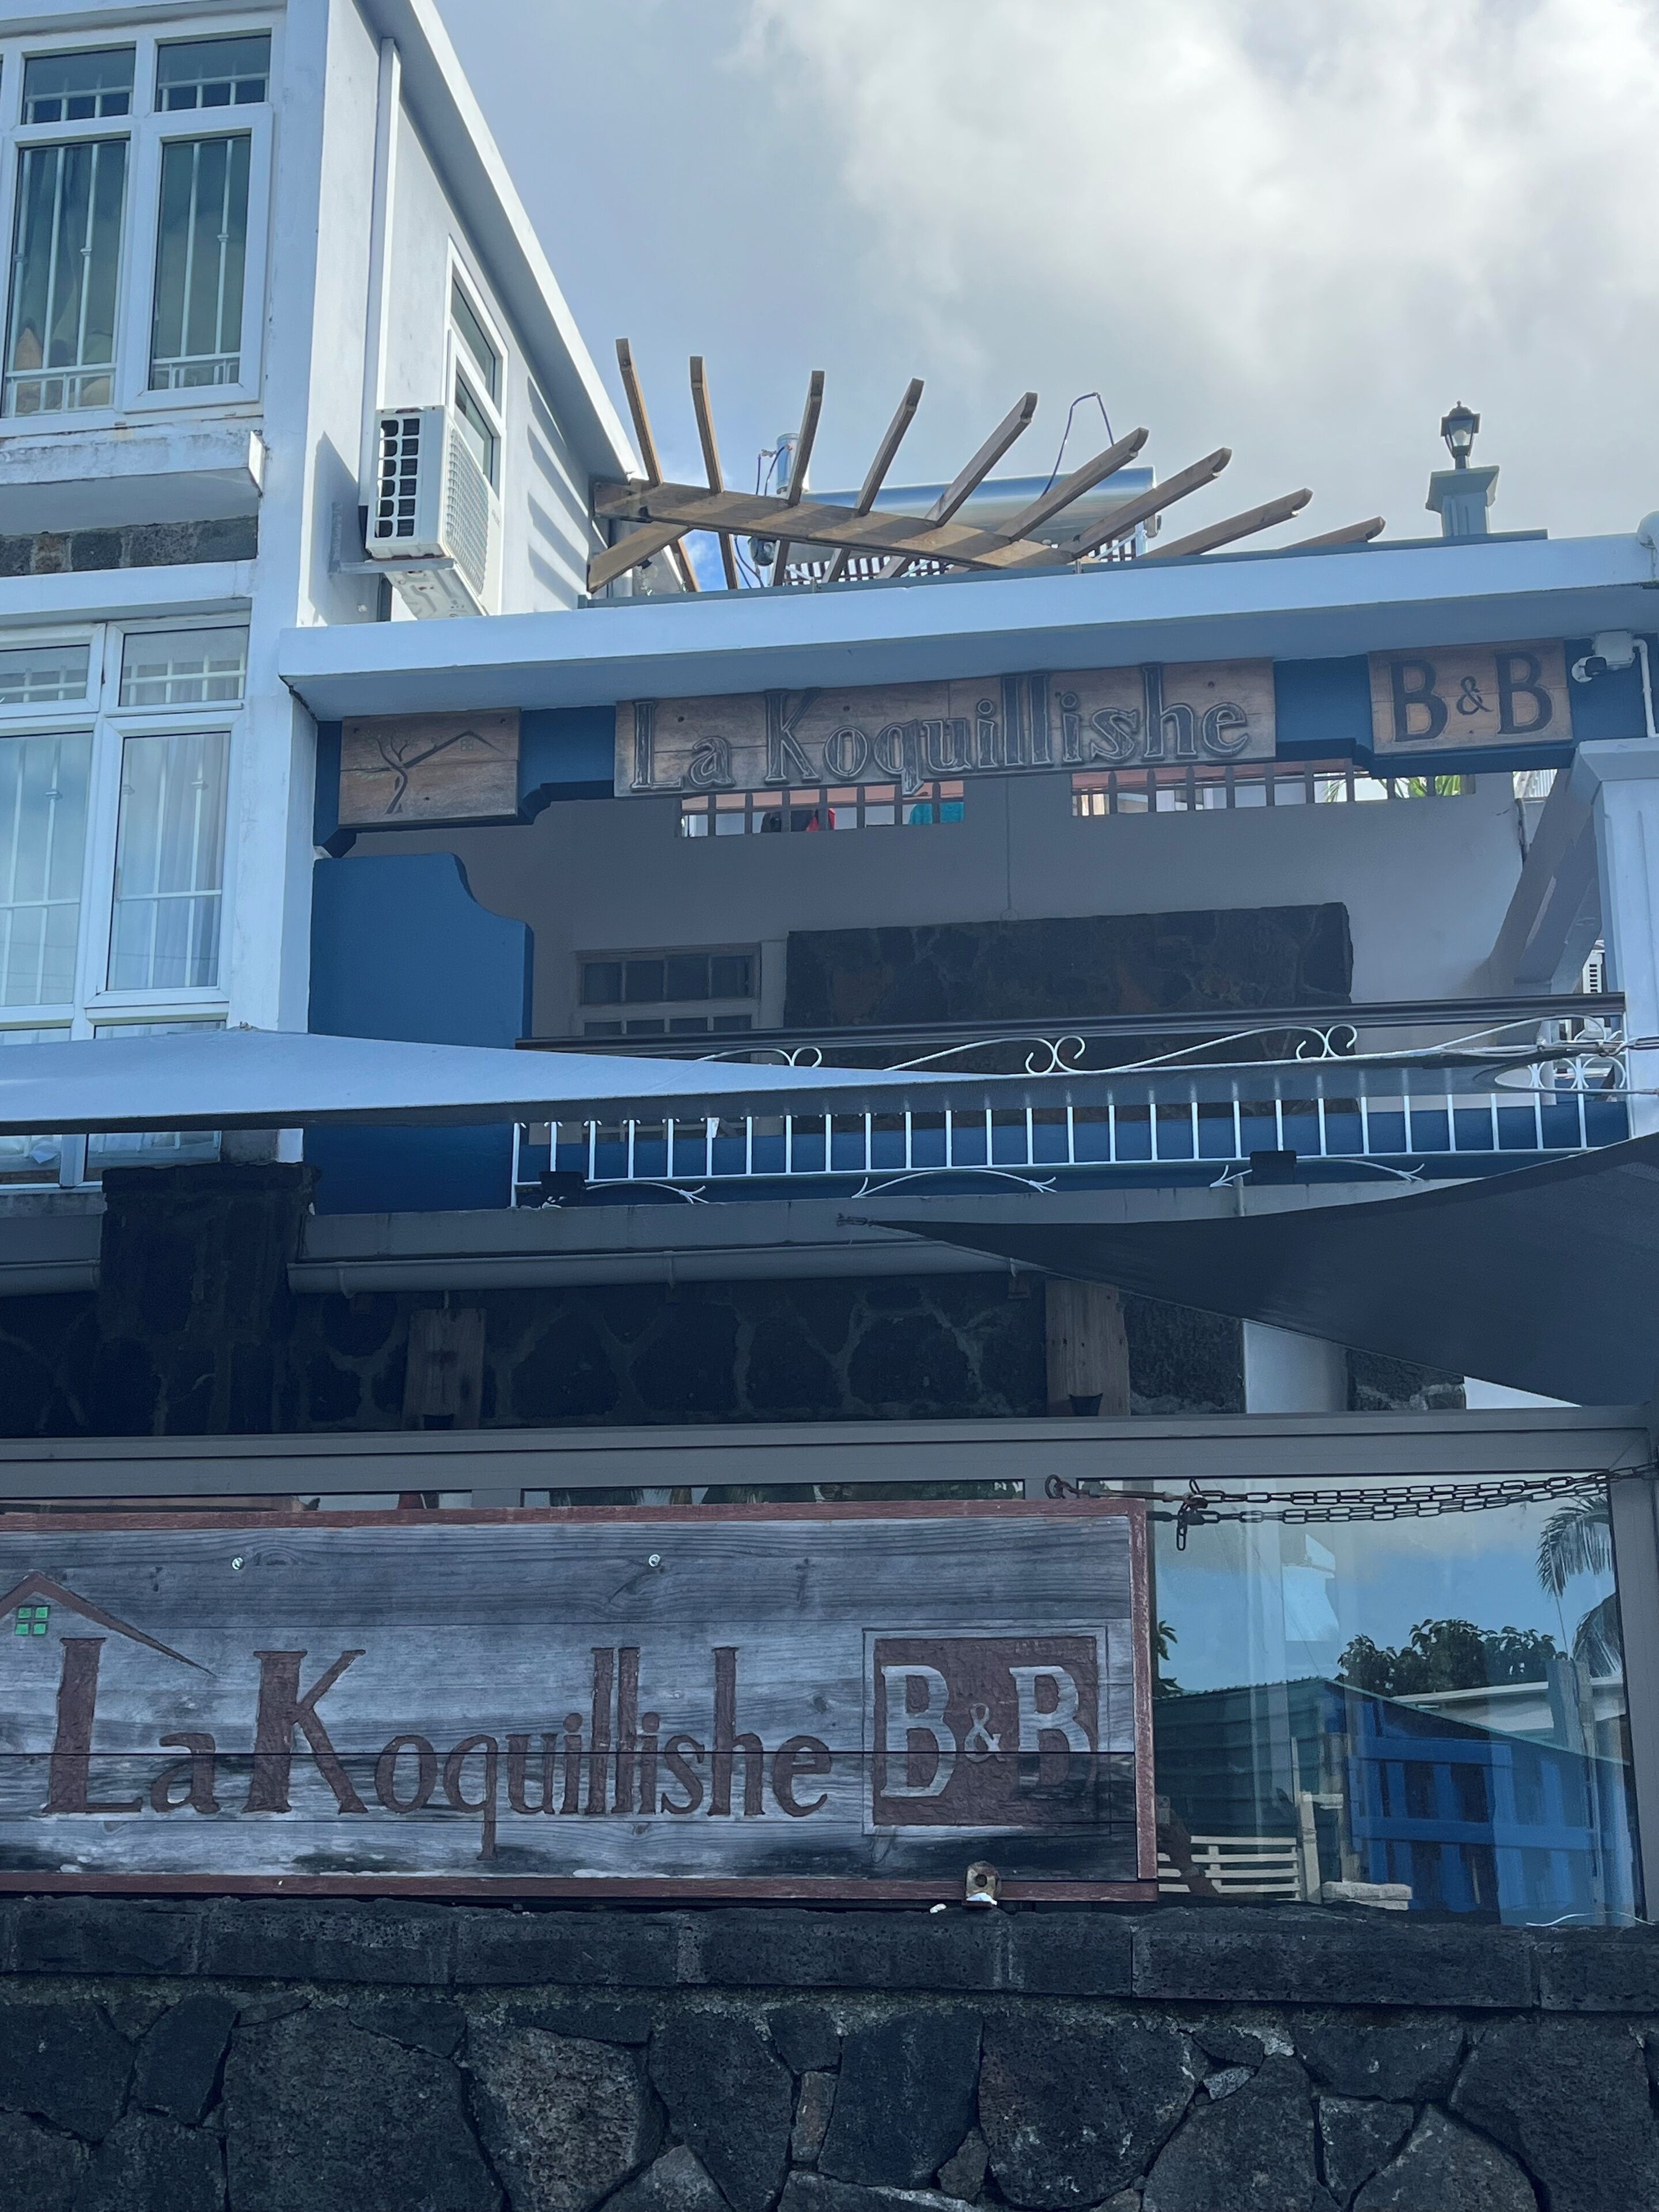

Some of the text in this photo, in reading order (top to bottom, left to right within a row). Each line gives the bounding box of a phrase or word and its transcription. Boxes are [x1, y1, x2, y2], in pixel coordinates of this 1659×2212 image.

[631, 662, 1249, 797] La Koquillishe
[1389, 650, 1554, 743] B&B
[41, 1637, 1093, 1861] La Koquillishe B&B
